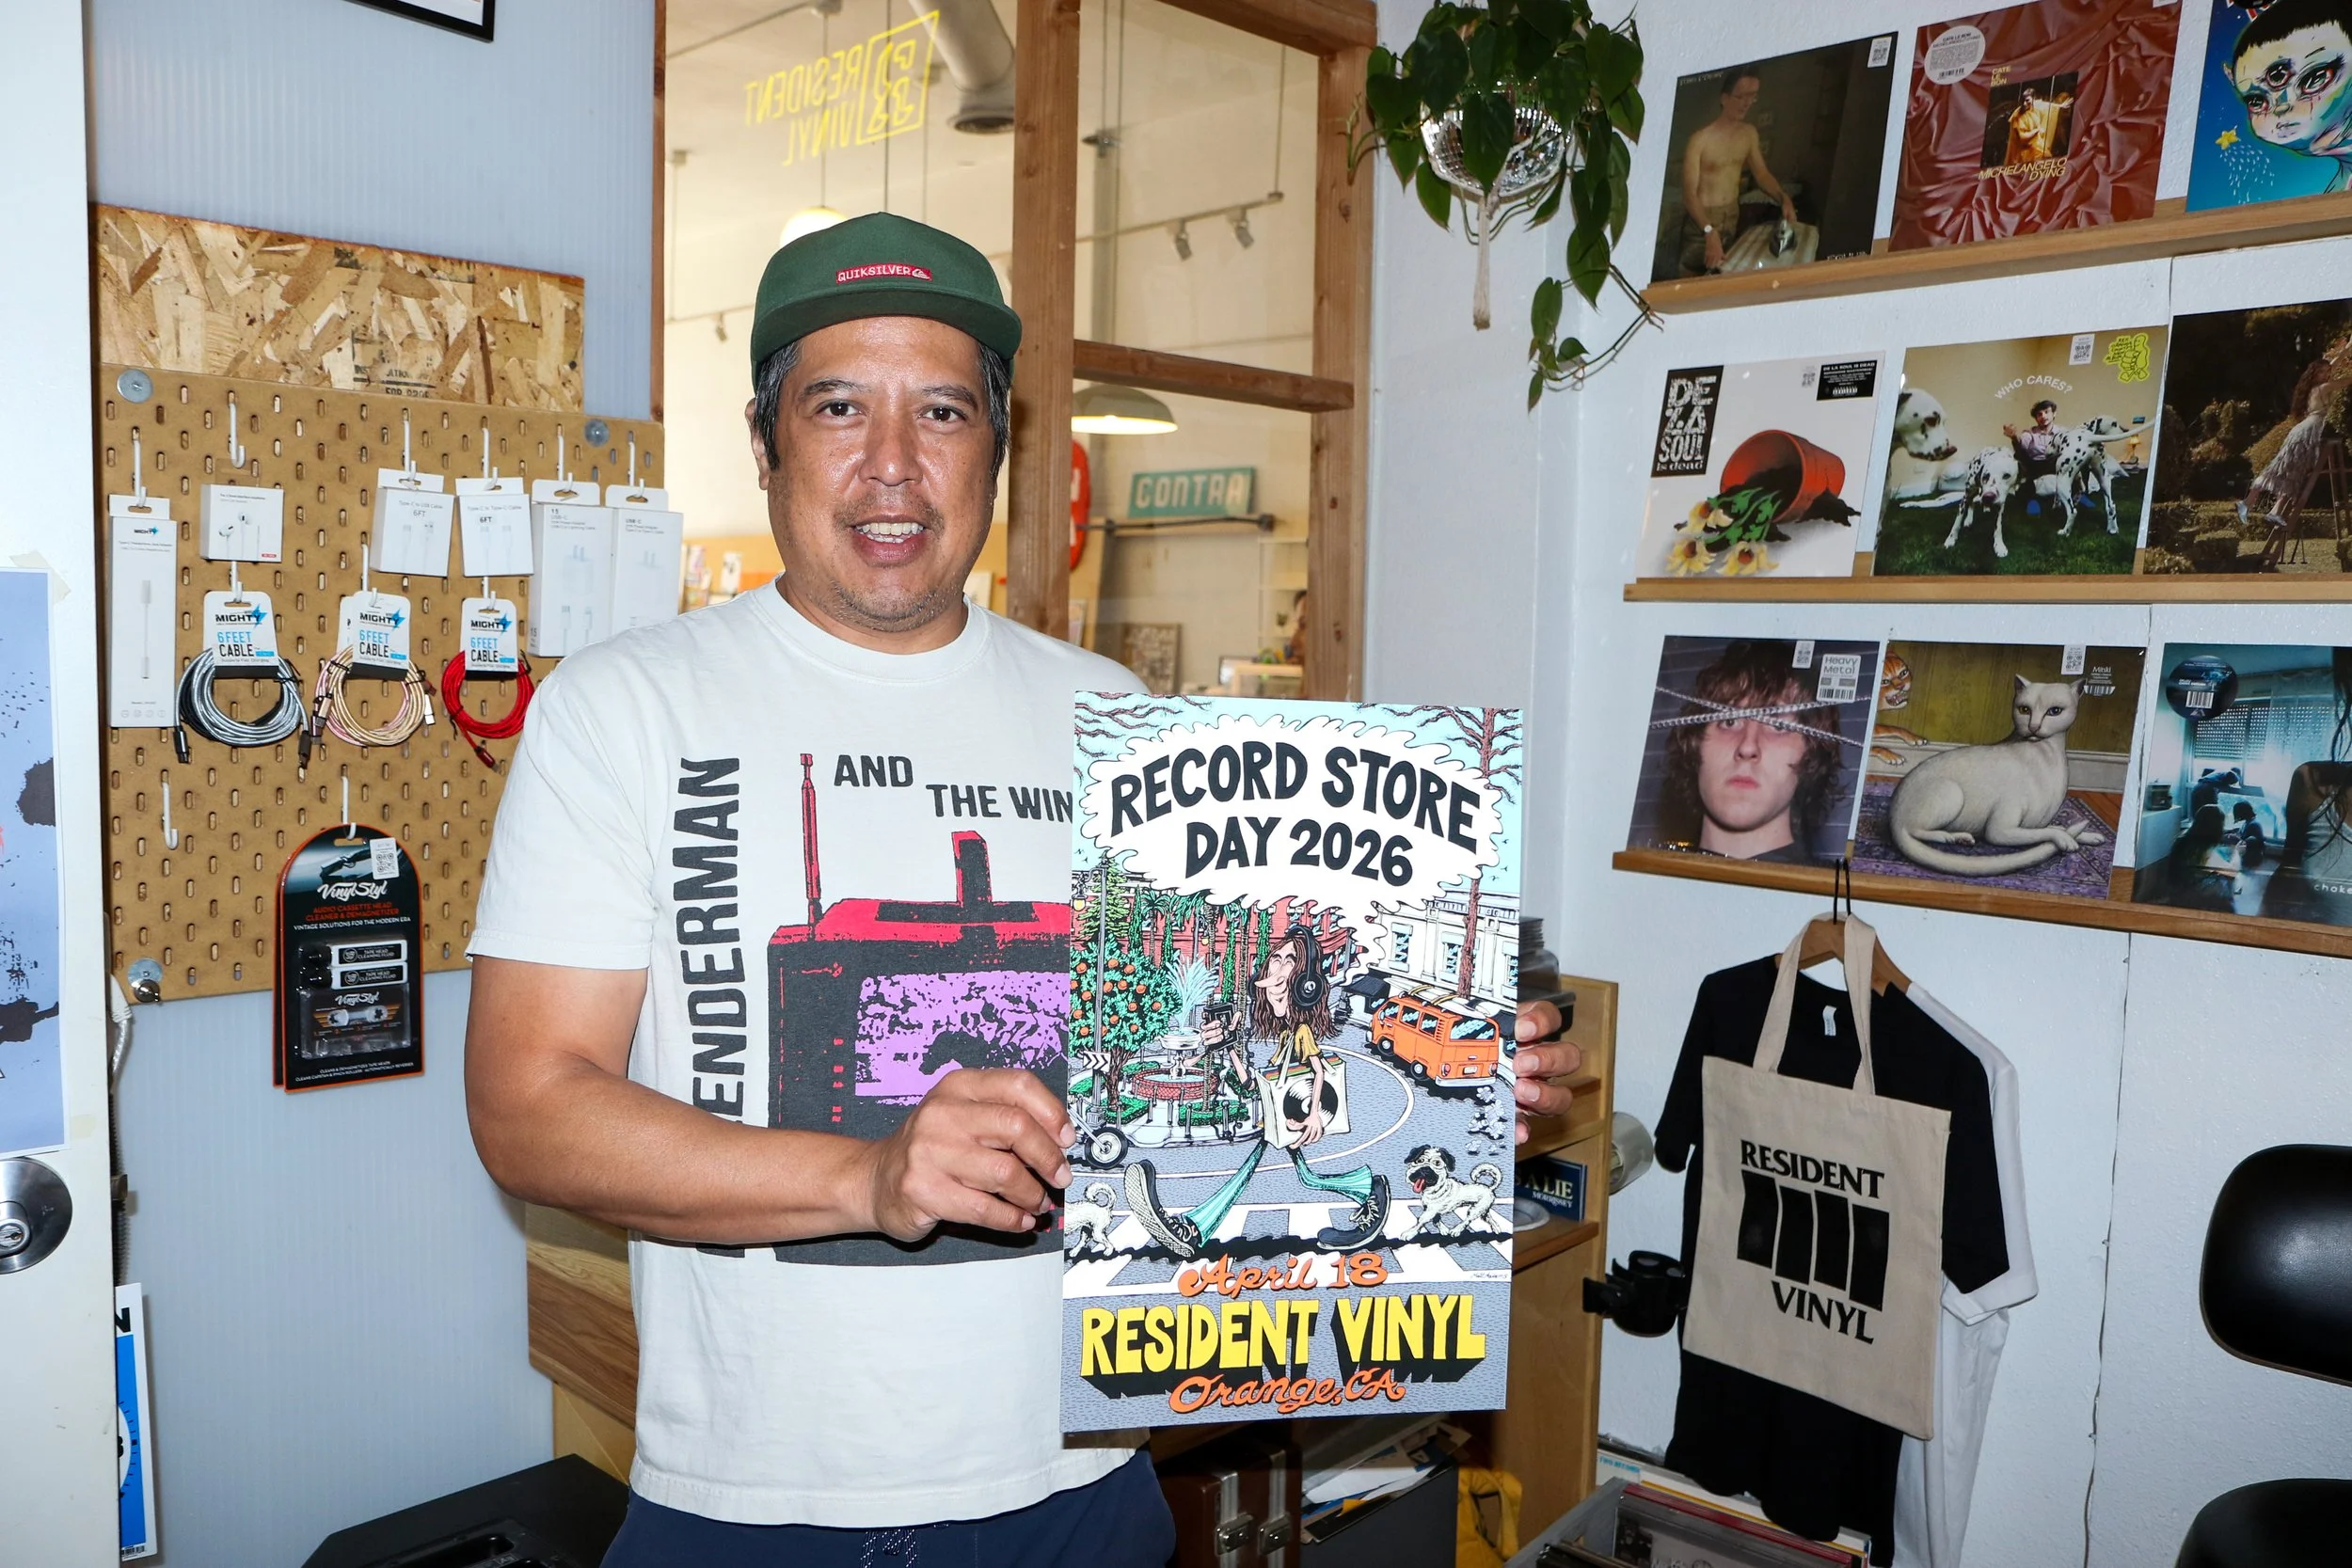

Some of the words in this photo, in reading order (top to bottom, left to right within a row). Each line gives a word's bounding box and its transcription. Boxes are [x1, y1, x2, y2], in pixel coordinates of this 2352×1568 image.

[1992, 65, 2011, 75] CATE
[1991, 78, 2008, 87] BON
[1979, 157, 2067, 180] MICHELANGELO
[2028, 166, 2066, 182] DYING
[837, 264, 912, 282] QUIKSILVER
[1667, 375, 1717, 407] DE
[1994, 378, 2023, 400] WHO
[2026, 375, 2073, 394] CARES?
[1658, 435, 1705, 464] SOUL
[1135, 472, 1246, 509] CONTRA
[215, 614, 262, 623] MIGHTY
[359, 612, 400, 626] MIGHTY
[470, 620, 507, 630] MIGHTY
[219, 644, 254, 657] CABLE
[359, 641, 389, 657] CABLE
[470, 649, 499, 663] CABLE
[1823, 666, 1855, 674] Metal
[1824, 657, 1858, 666] Heavy
[834, 754, 914, 787] AND
[926, 784, 1002, 817] THE
[1009, 786, 1073, 824] WIN
[1111, 740, 1308, 838] RECORD
[1322, 746, 1480, 854] STORE
[1185, 816, 1281, 879] DAY
[1290, 818, 1413, 886] 2026
[2314, 883, 2352, 894] choke
[306, 912, 339, 921] CLEANER
[346, 909, 399, 918] DEMAGNETIZER
[337, 903, 372, 911] CASSETTE
[294, 923, 318, 931] VINTAGE
[319, 921, 351, 929] SOLUTIONS
[673, 757, 746, 1124] ENDERMAN
[1740, 1139, 1885, 1199] RESIDENT
[1524, 1173, 1541, 1191] A
[1543, 1175, 1574, 1199] LIE
[1532, 1191, 1573, 1209] MORRISSEY
[1178, 1252, 1318, 1299] April
[1329, 1252, 1389, 1289] 18
[1771, 1279, 1874, 1345] VINYL
[1080, 1299, 1319, 1377] RESIDENT
[1336, 1294, 1486, 1363] VINYL
